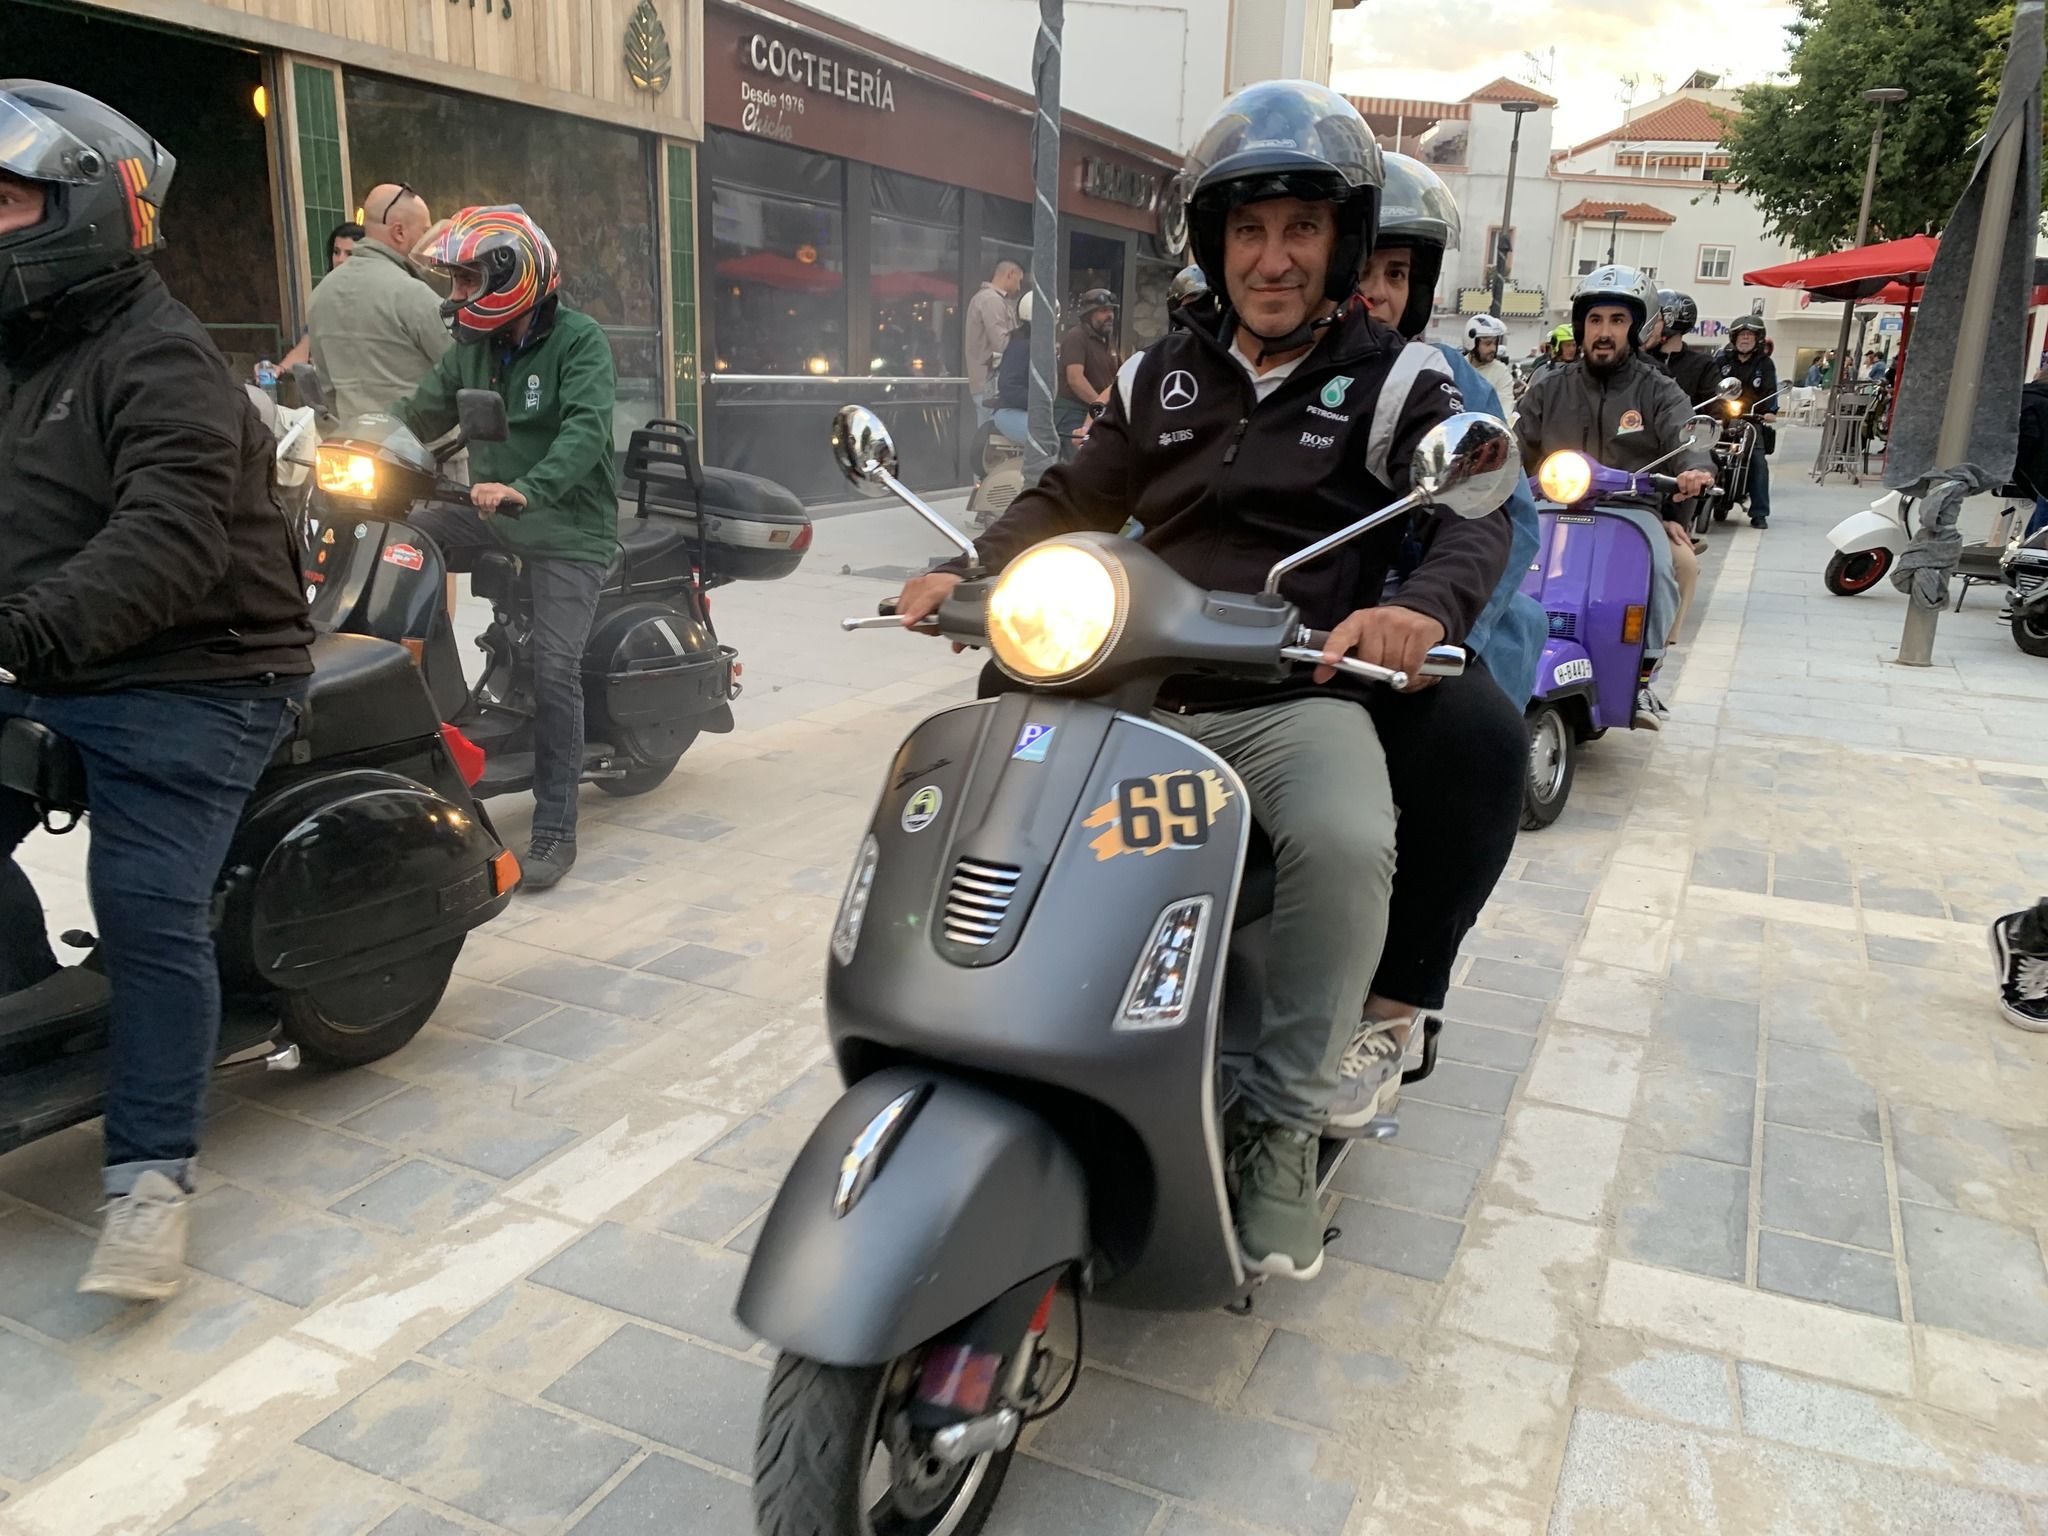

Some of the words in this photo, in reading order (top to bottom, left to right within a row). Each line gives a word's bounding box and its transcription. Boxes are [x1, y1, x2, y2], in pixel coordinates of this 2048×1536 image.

[751, 34, 895, 112] COCTELERÍA
[741, 81, 777, 107] Desde
[780, 93, 805, 115] 1976
[1306, 405, 1349, 422] PETRONAS
[1172, 429, 1194, 442] UBS
[1018, 725, 1043, 746] P
[1119, 774, 1209, 848] 69
